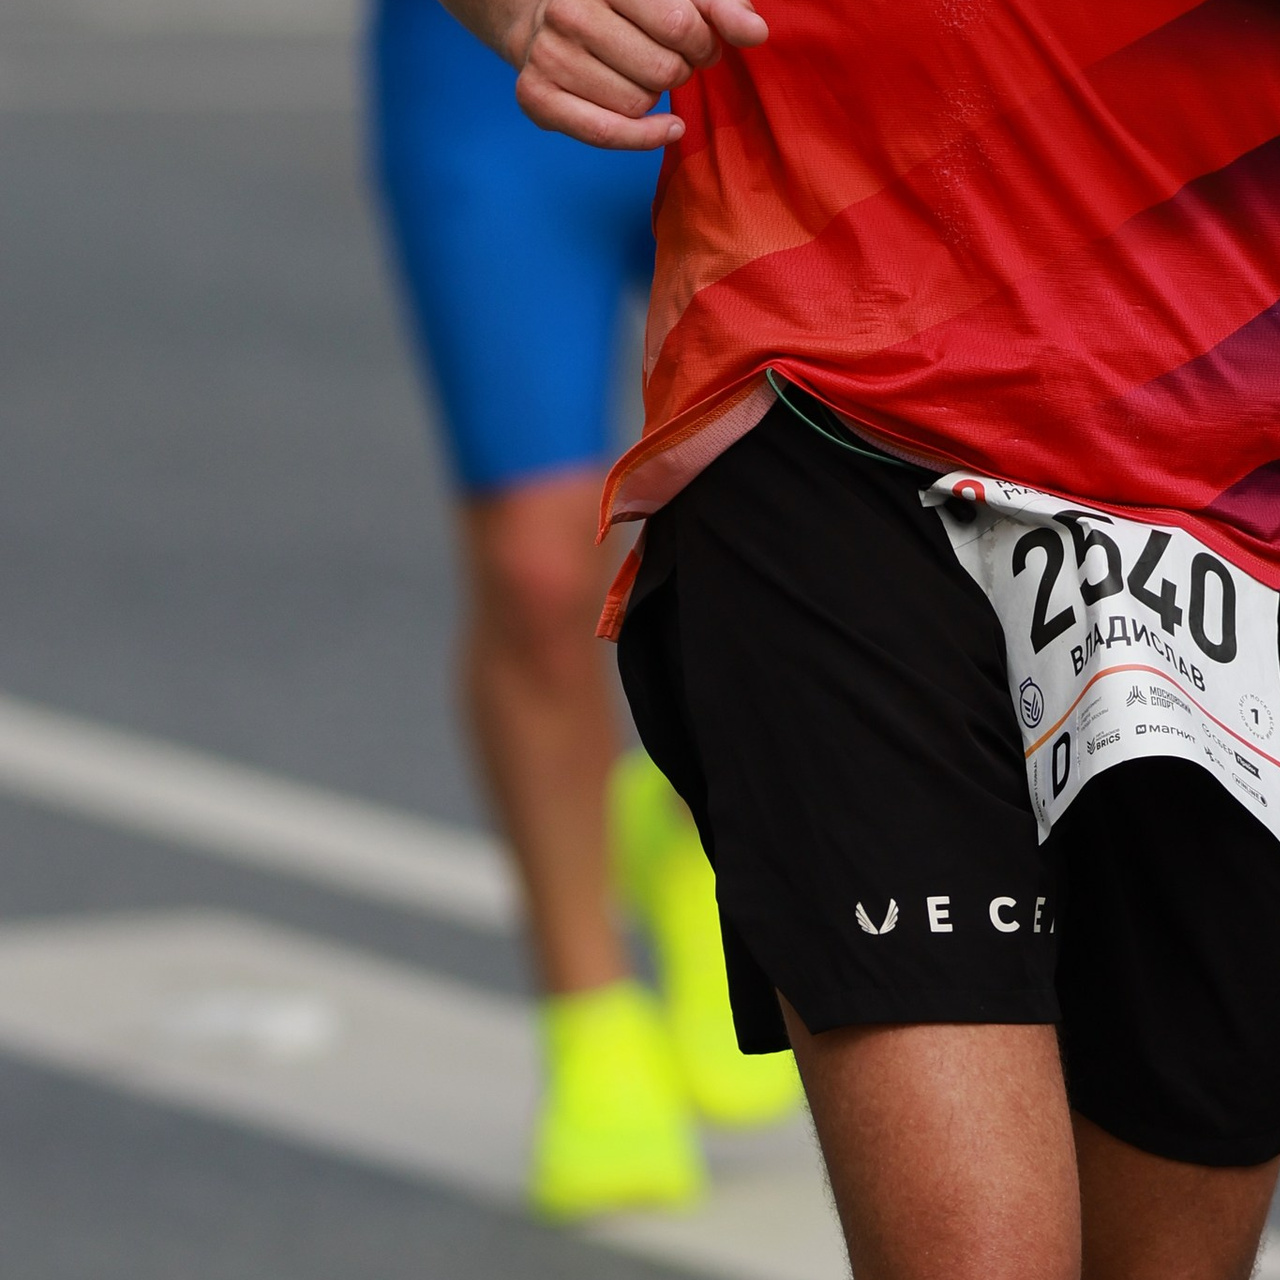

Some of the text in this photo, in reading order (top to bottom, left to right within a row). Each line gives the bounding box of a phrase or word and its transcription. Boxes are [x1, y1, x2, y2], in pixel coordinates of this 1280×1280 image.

[1012, 510, 1237, 664] 2540
[1070, 616, 1206, 692] ВЛАДИСЛАВ
[1151, 696, 1175, 712] СПОРТ
[1250, 708, 1259, 726] 1
[1096, 733, 1121, 751] BRICS
[1052, 731, 1071, 800] D
